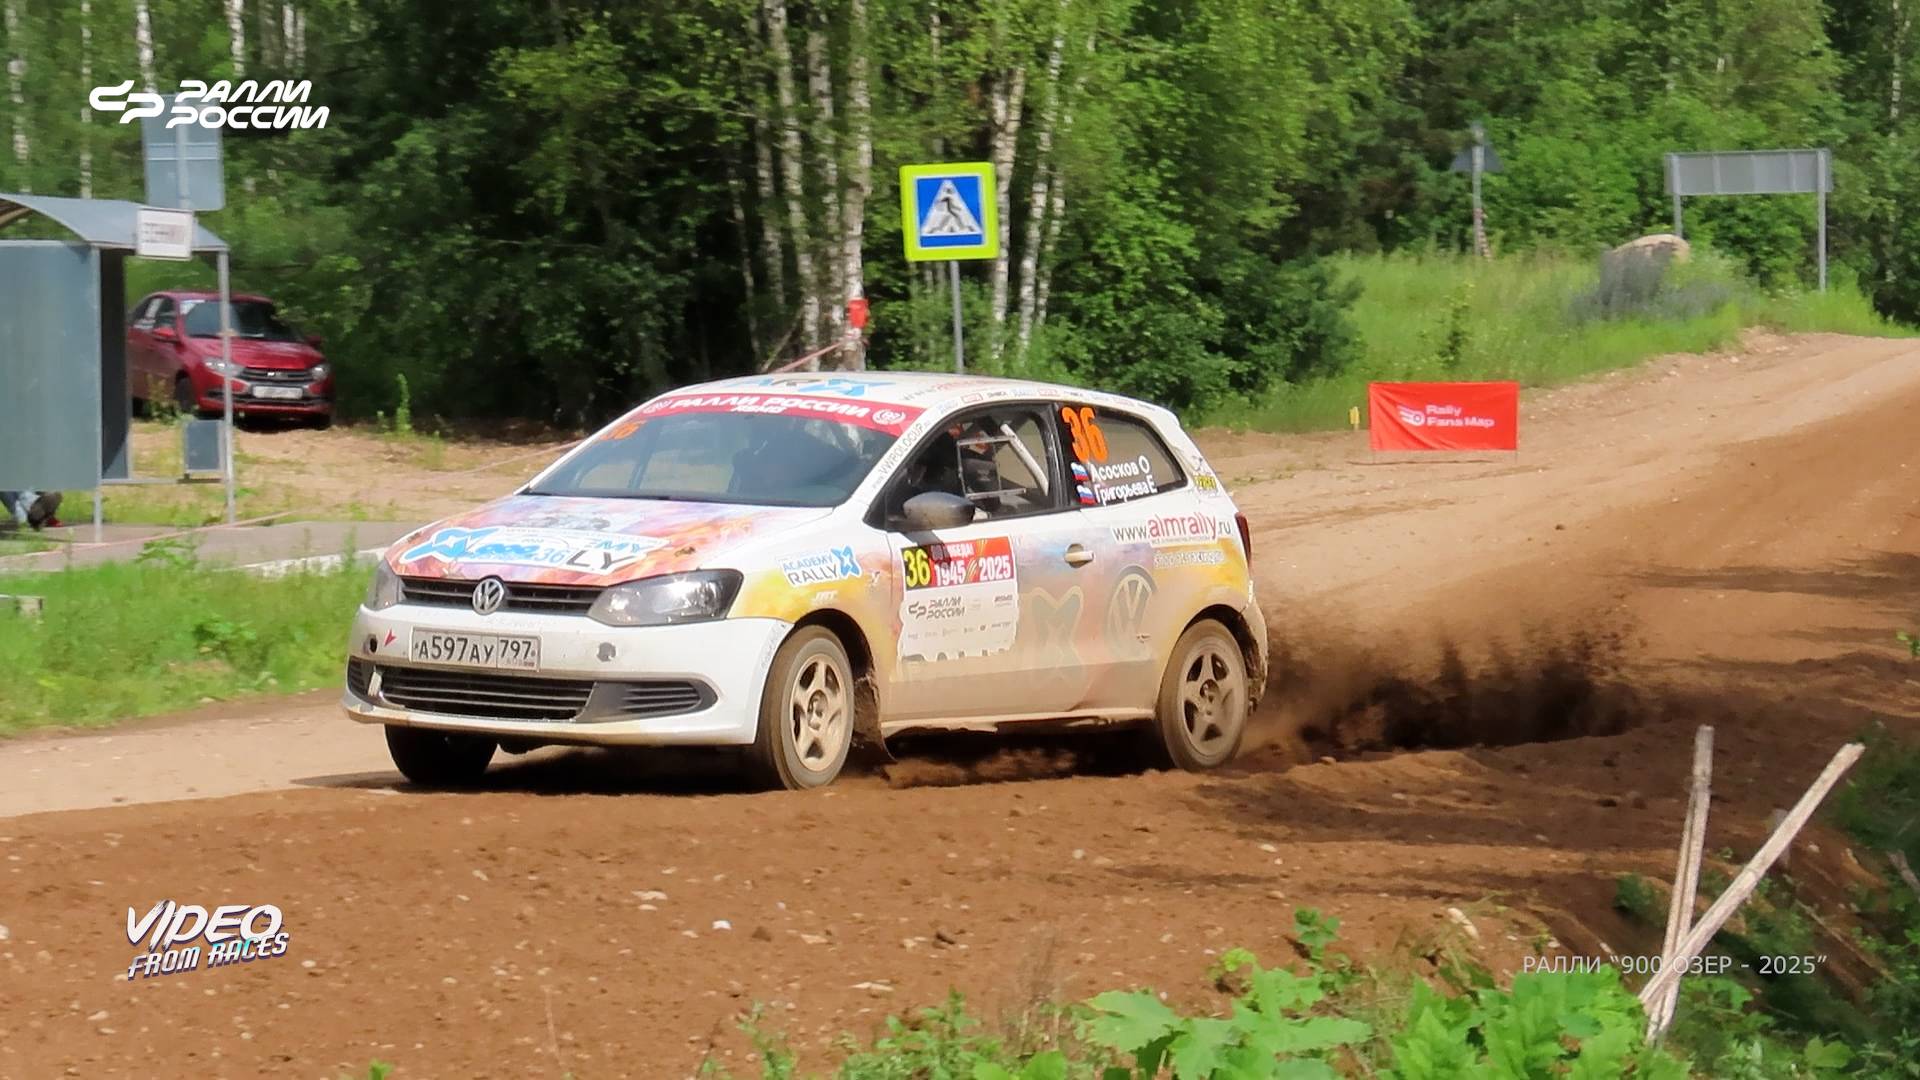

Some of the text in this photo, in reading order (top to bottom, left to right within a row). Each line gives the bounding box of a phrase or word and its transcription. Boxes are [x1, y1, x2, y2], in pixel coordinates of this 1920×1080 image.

[670, 396, 761, 409] РАЛЛИ
[762, 397, 870, 418] РОССИИ
[1426, 404, 1462, 416] Rally
[1427, 416, 1495, 429] Fans Map
[1061, 407, 1109, 463] 36
[1090, 455, 1150, 482] Асосков О
[1094, 475, 1158, 506] Григорьева Е
[783, 554, 833, 571] ACADEMY
[903, 549, 931, 588] 36
[934, 554, 1012, 587] 1945 2025
[788, 564, 839, 585] RALLY
[500, 639, 532, 660] 797
